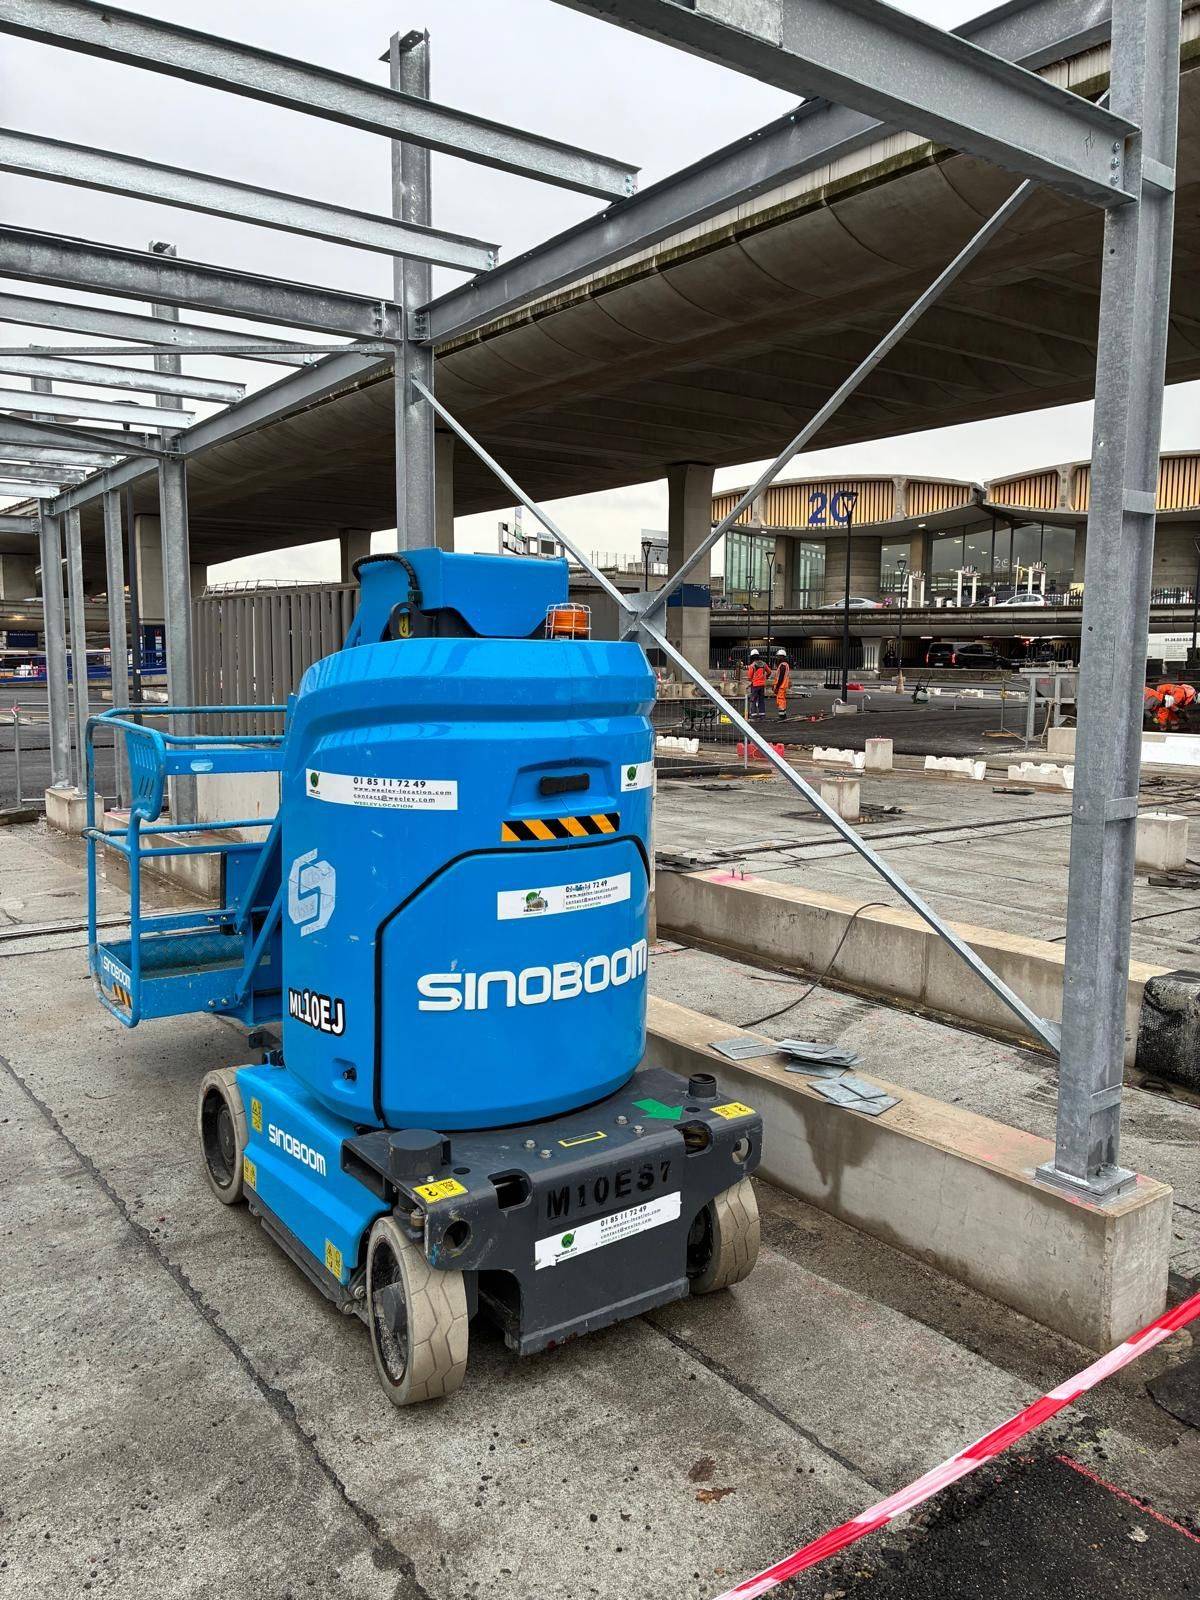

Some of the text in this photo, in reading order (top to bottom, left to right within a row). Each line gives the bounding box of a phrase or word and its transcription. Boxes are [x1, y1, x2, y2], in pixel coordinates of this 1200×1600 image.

[366, 778, 378, 786] 85
[397, 780, 410, 788] 72
[413, 780, 426, 788] 49
[592, 881, 600, 889] 72
[600, 879, 608, 887] 49
[103, 955, 131, 989] SINOBOOM
[417, 938, 648, 1012] SINOBOOM
[289, 989, 344, 1035] ML10EJ
[268, 1123, 326, 1176] SINOBOOM
[600, 1205, 647, 1227] 01 85 11 72 49
